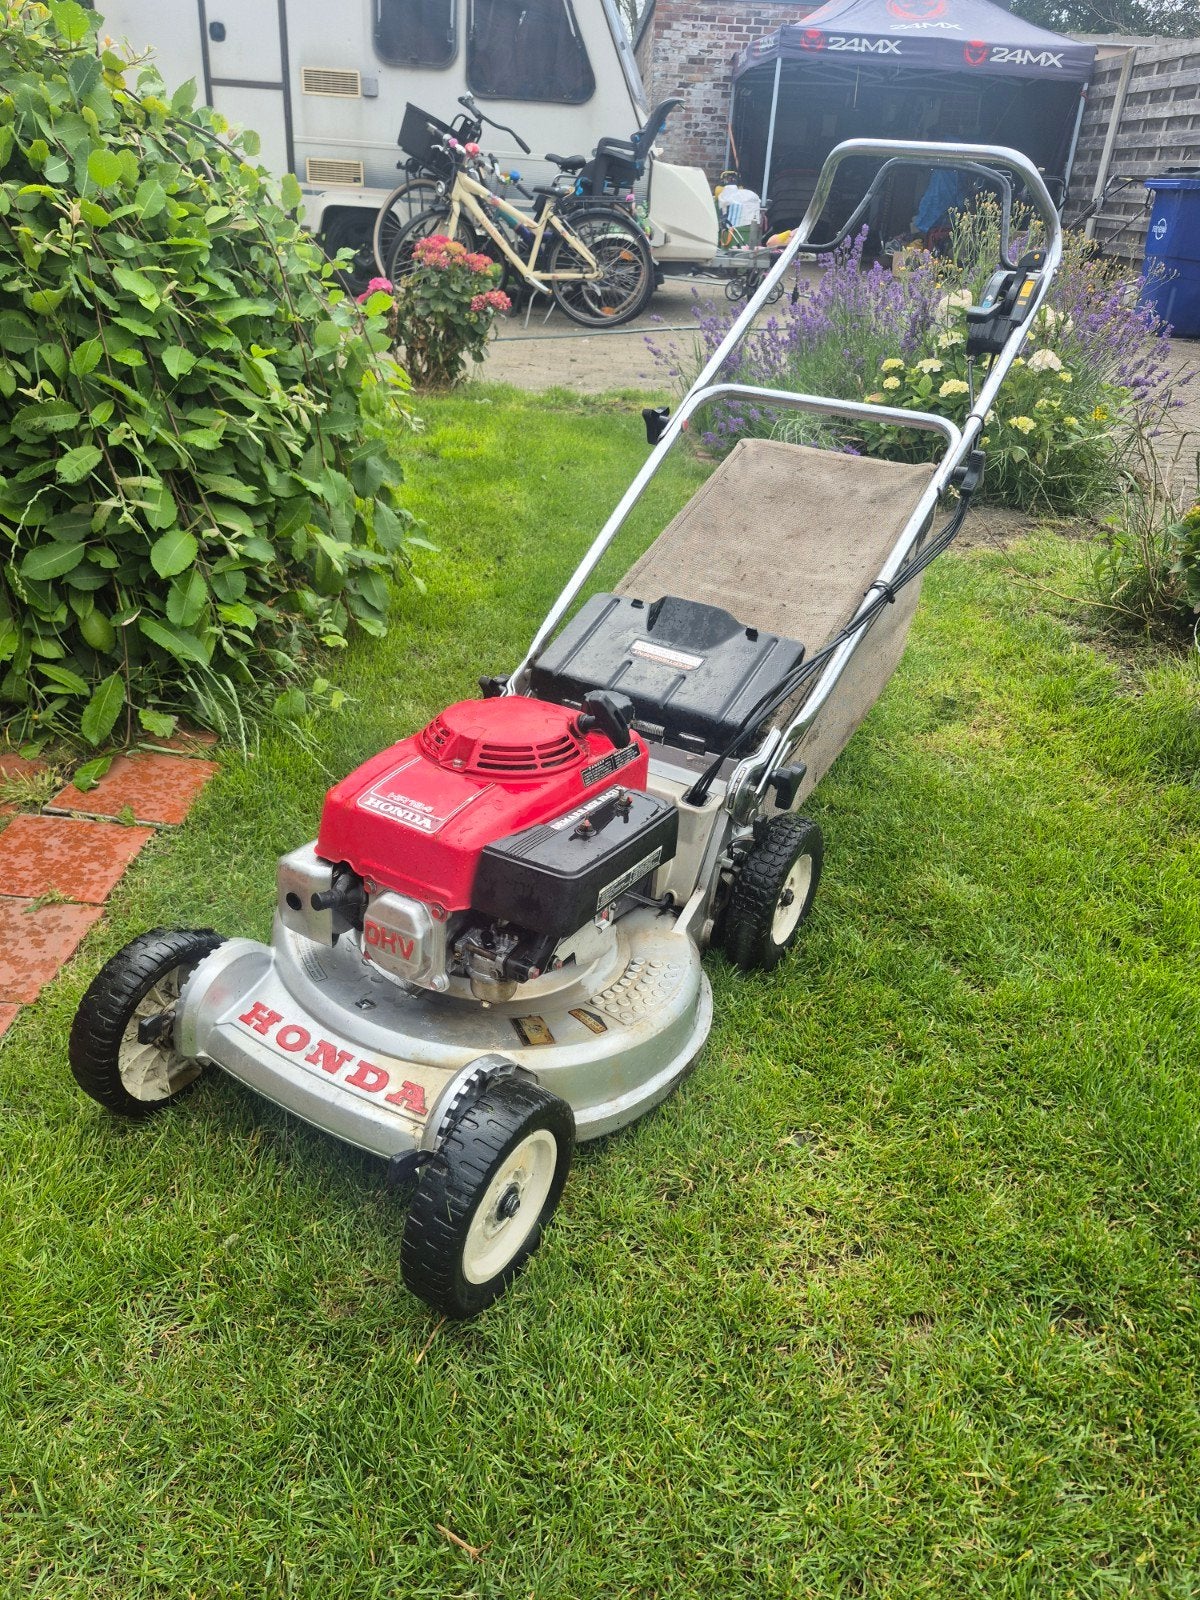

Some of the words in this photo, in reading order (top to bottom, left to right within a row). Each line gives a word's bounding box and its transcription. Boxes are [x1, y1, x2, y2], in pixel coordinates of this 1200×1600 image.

[889, 21, 963, 31] 24MX
[827, 37, 902, 55] 24MX
[989, 47, 1065, 68] 24MX
[364, 797, 432, 829] HONDA
[365, 920, 415, 960] OHV
[238, 1001, 429, 1116] HONDA
